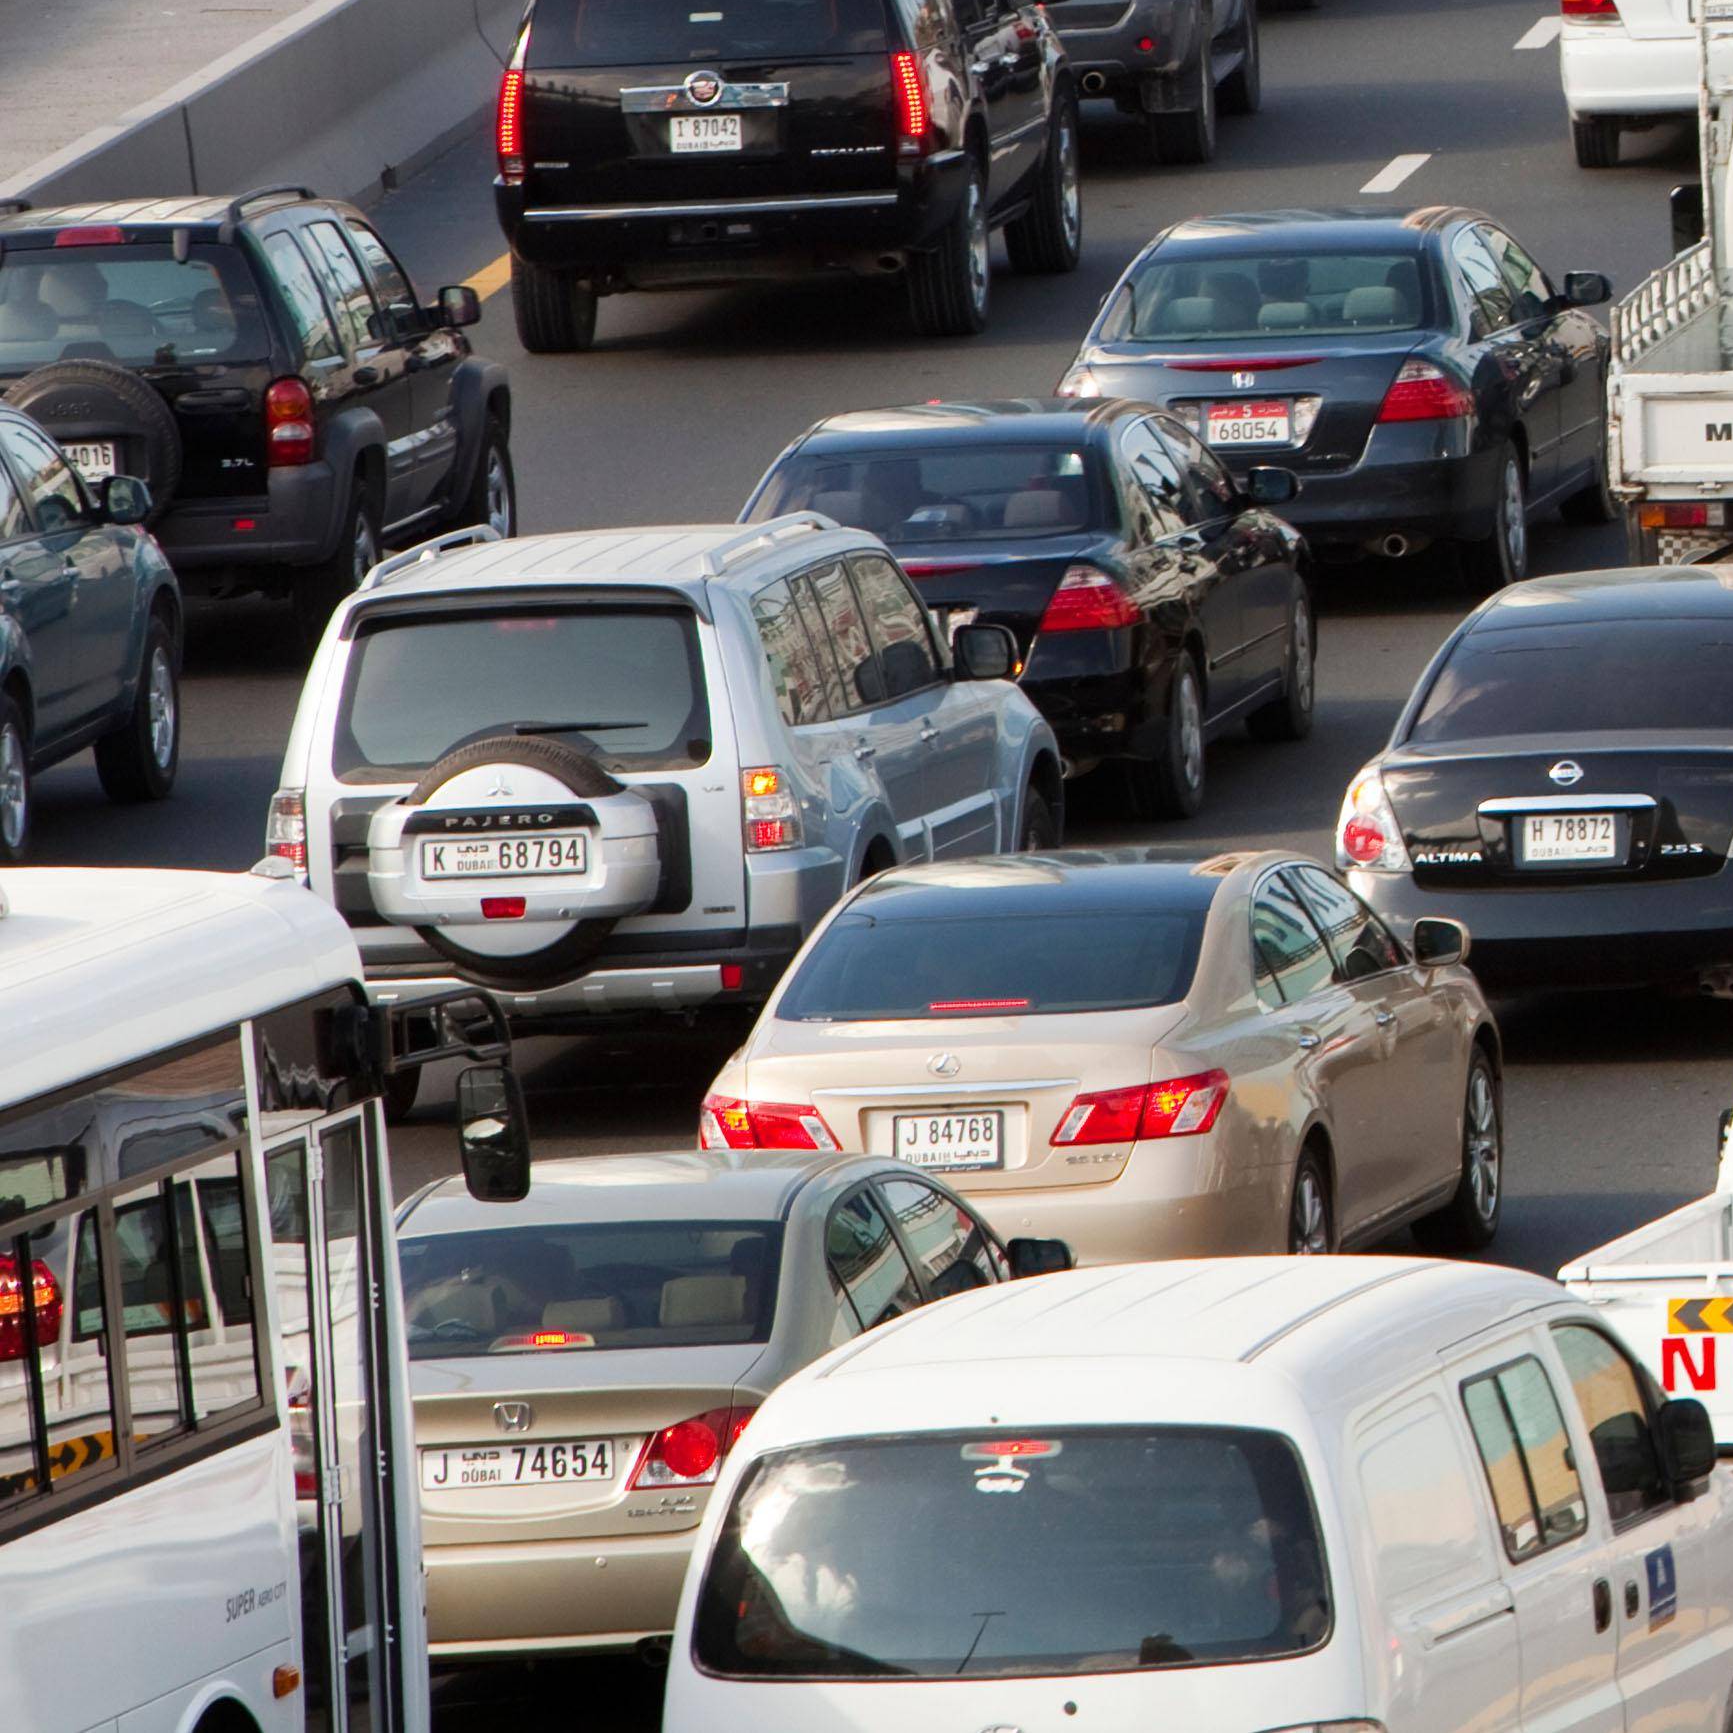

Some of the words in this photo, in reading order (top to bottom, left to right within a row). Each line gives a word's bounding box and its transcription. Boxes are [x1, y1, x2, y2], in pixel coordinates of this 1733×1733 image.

[693, 117, 738, 137] 87042
[1242, 404, 1253, 419] 5
[1219, 419, 1278, 441] 68054
[445, 812, 555, 830] PAJERO
[1532, 820, 1543, 842] H
[1555, 817, 1611, 842] 78872
[432, 849, 447, 872] K
[499, 838, 581, 870] 68794
[1414, 851, 1483, 864] ALTIMA
[906, 1122, 918, 1145] J
[929, 1117, 994, 1145] 84768
[433, 1453, 449, 1483] J
[512, 1443, 609, 1480] 74654
[462, 1469, 502, 1483] DUBAI
[226, 1587, 255, 1624] SUPER
